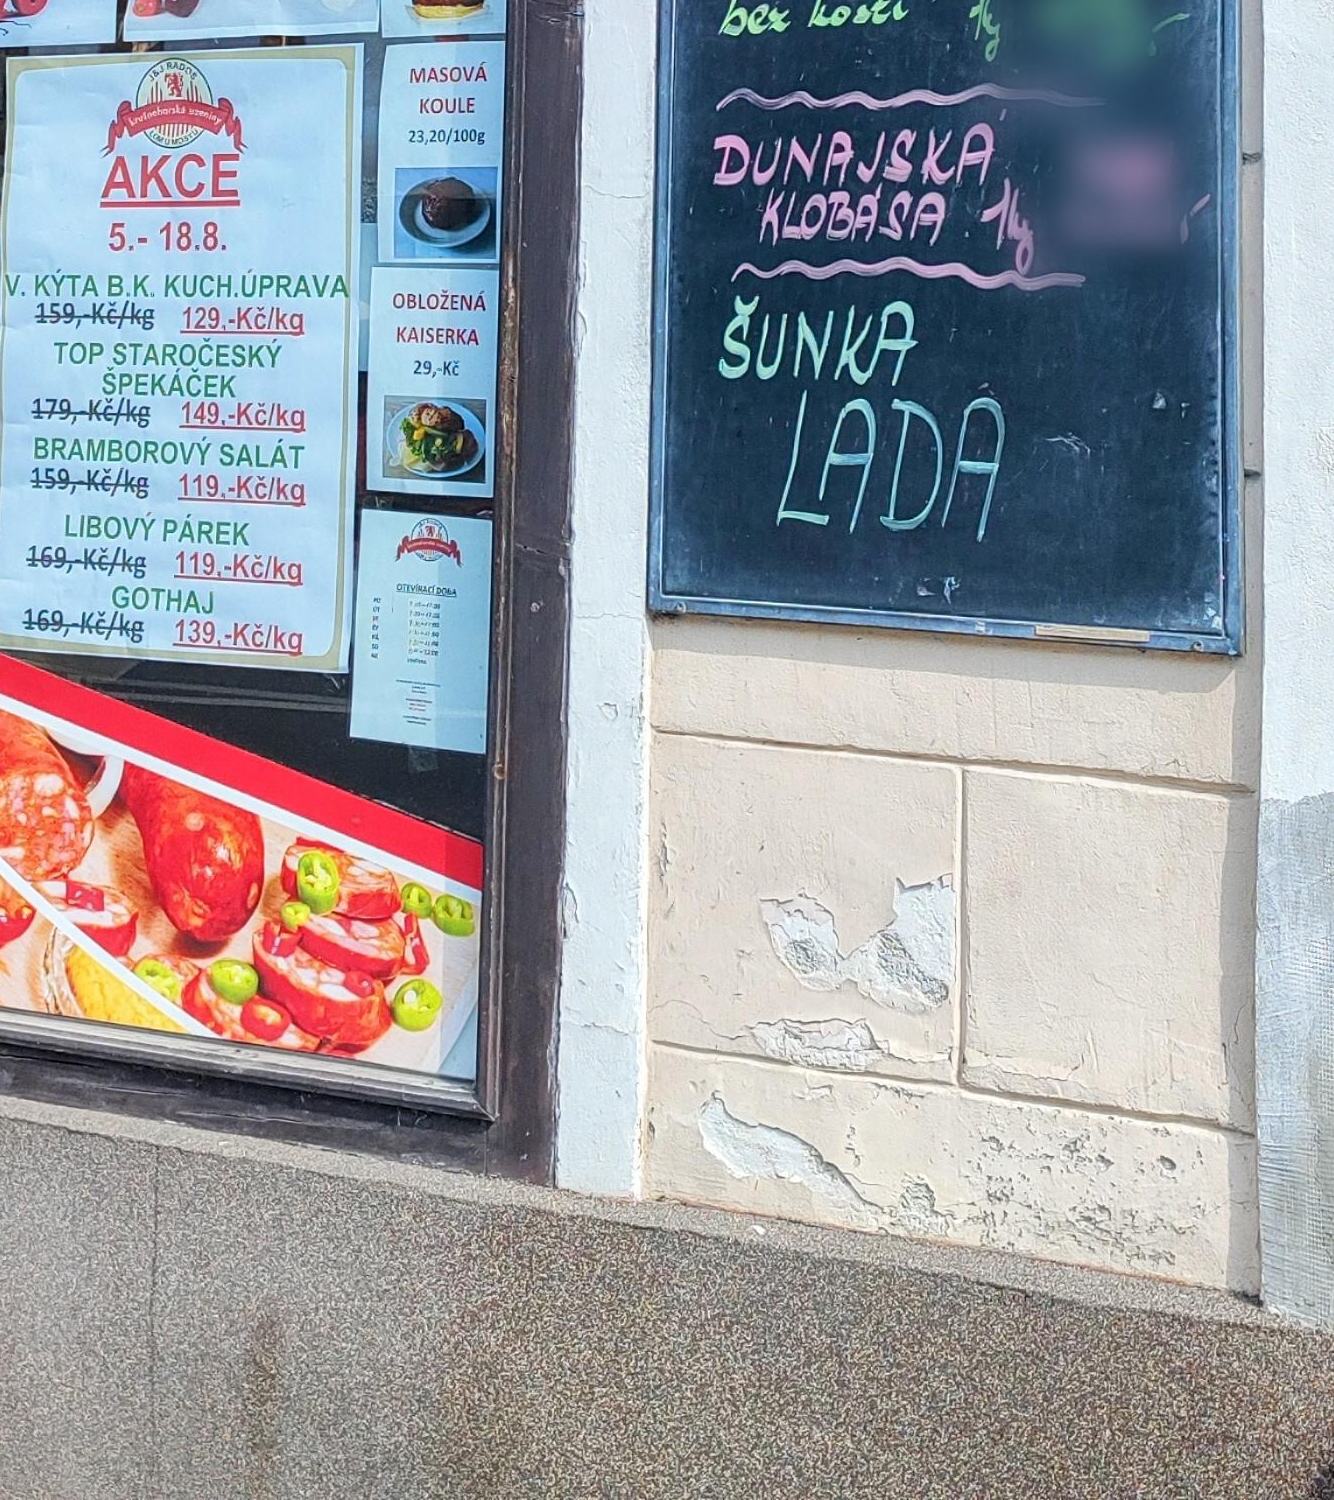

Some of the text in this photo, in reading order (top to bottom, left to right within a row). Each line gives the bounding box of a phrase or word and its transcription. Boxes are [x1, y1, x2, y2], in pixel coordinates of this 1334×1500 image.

[410, 62, 487, 83] MASOVÁ
[419, 97, 475, 114] KOULE
[408, 128, 485, 146] 23,20/100g
[712, 108, 1008, 186] DUNAJSKÁ
[101, 153, 240, 199] AKCE
[759, 182, 946, 247] KLOBÁSA
[159, 221, 227, 251] 18.8.
[4, 274, 26, 297] V.
[34, 269, 99, 297] KÝTA
[107, 274, 156, 298] B.K.
[393, 289, 486, 312] OBLOŽENÁ
[35, 301, 304, 334] 159,-Kč/kg 129,-Kč/kg
[396, 326, 479, 346] KAISERKA
[718, 296, 918, 386] ŠUNKA
[54, 338, 282, 368] TOP STAROČESKÝ
[413, 359, 460, 378] 29,-Kč
[102, 368, 237, 398] ŠPEKÁČEK
[31, 398, 306, 433] 179,-Kč/kg 149,-Kč/kg
[33, 437, 305, 469] BRAMBOROVÝ SALÁT
[776, 390, 1007, 542] LADA
[30, 467, 306, 506] 159,-Kč/kg 119,-Kč/kg
[65, 512, 250, 546] LIBOVÝ PÁREK
[26, 546, 303, 585] 169,-Kč/kg 119,-Kč/kg
[111, 586, 215, 615] GOTHAJ
[23, 608, 303, 655] 169,-Kč/kg 139,-Kč/kg
